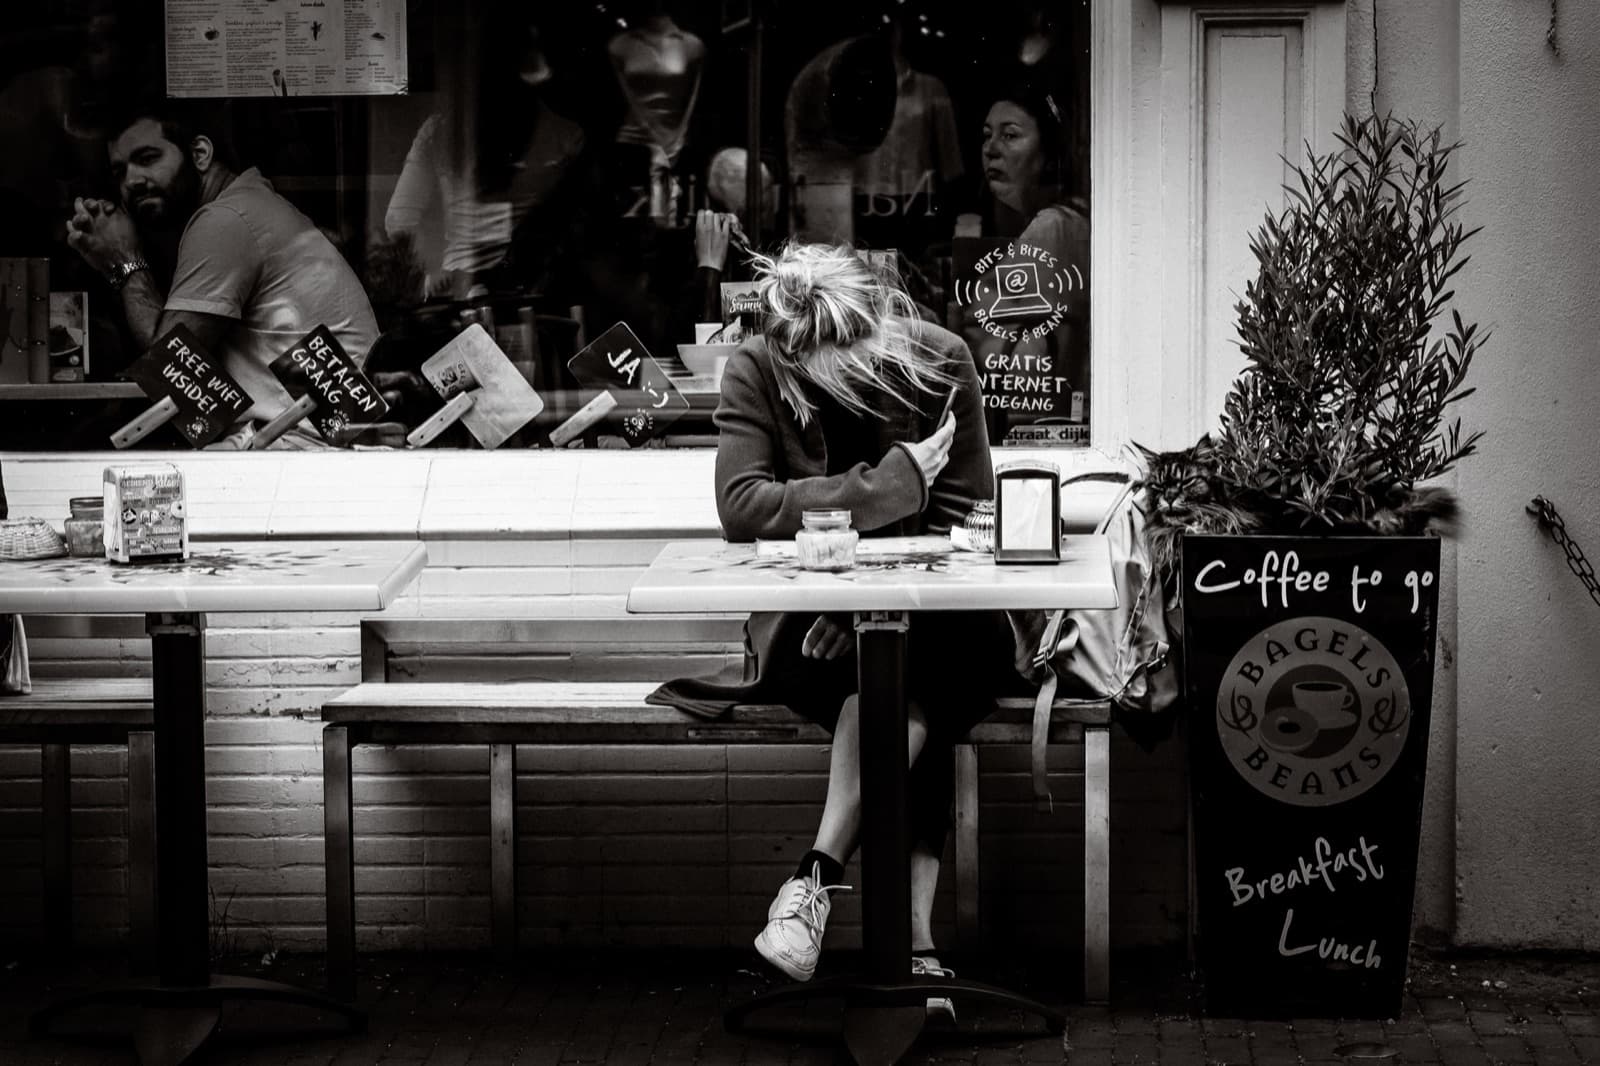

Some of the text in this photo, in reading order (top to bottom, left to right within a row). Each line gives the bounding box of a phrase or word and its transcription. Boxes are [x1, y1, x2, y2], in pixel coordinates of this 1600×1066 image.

[974, 247, 1004, 274] BITS
[974, 308, 1018, 343] BAGELS
[1032, 302, 1068, 339] BEANS
[167, 337, 211, 378] FREE
[291, 348, 343, 404] GRAAG
[308, 335, 377, 412] BETALEN
[607, 348, 640, 385] JA
[977, 373, 1067, 393] NTERNET
[981, 394, 1054, 412] TOEGANG
[1194, 550, 1434, 613] Coffee to go
[1237, 628, 1391, 688] BAGELS
[1243, 746, 1381, 794] BEANS
[1225, 836, 1384, 907] Breakfast
[1278, 908, 1382, 968] Lunch
